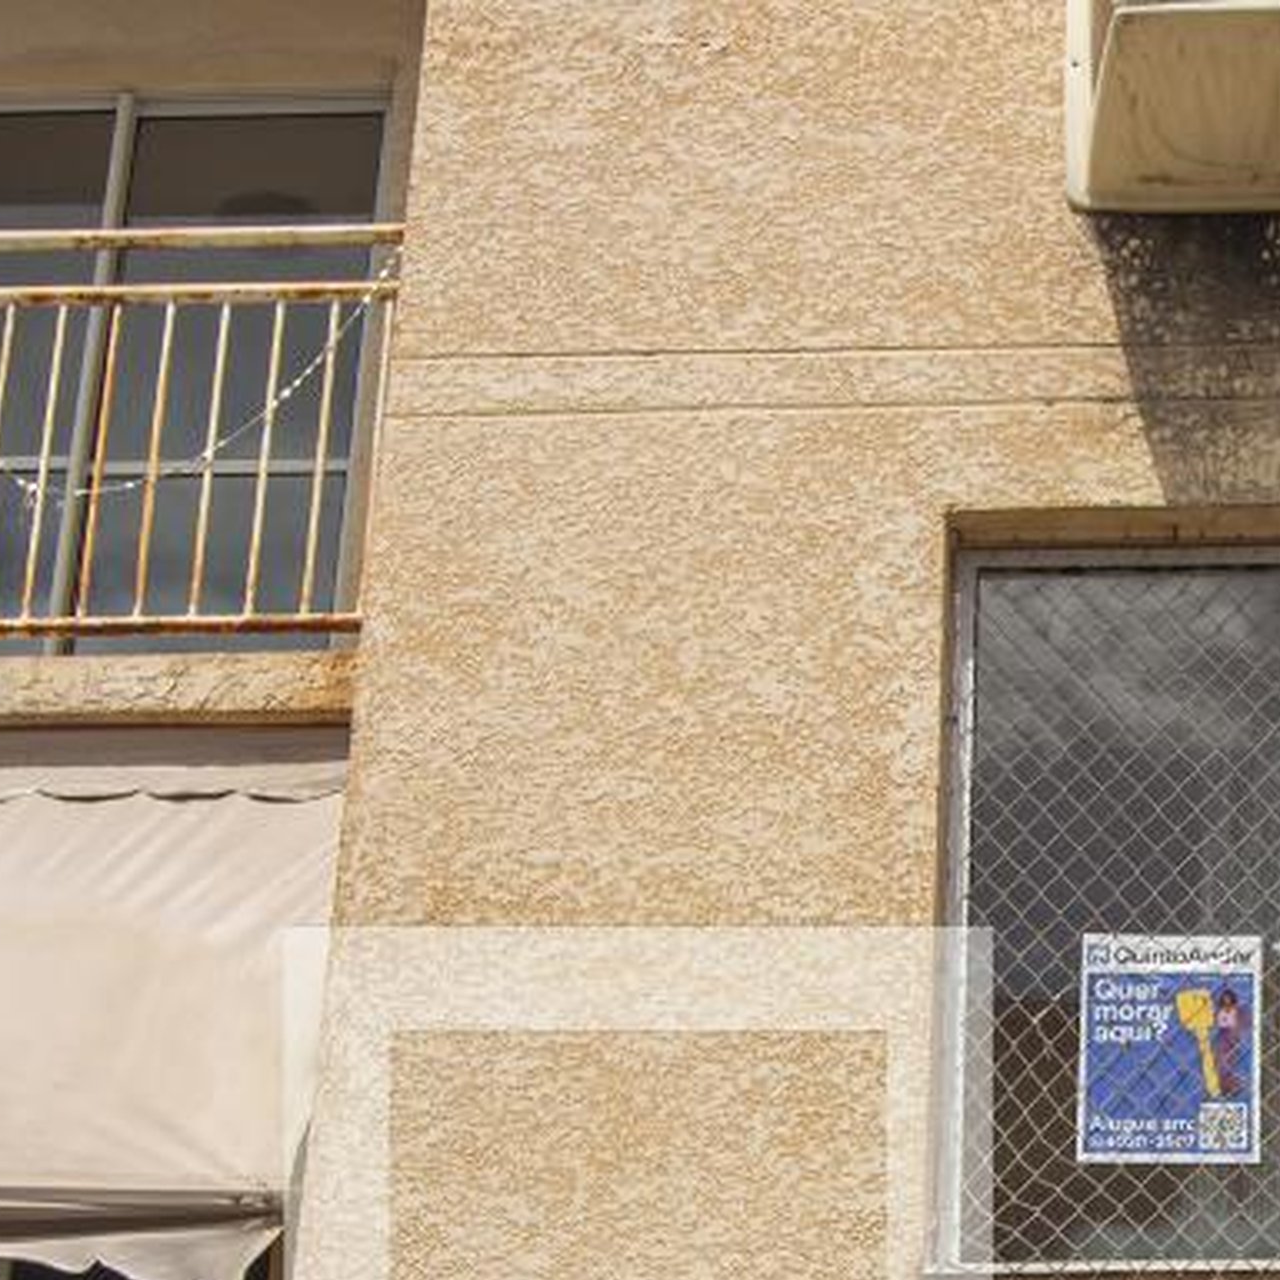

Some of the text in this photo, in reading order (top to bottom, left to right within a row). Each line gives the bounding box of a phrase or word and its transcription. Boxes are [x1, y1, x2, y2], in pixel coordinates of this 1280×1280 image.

[1094, 978, 1161, 1000] Quer
[1094, 1004, 1174, 1021] morar
[1094, 1022, 1168, 1044] aqui?
